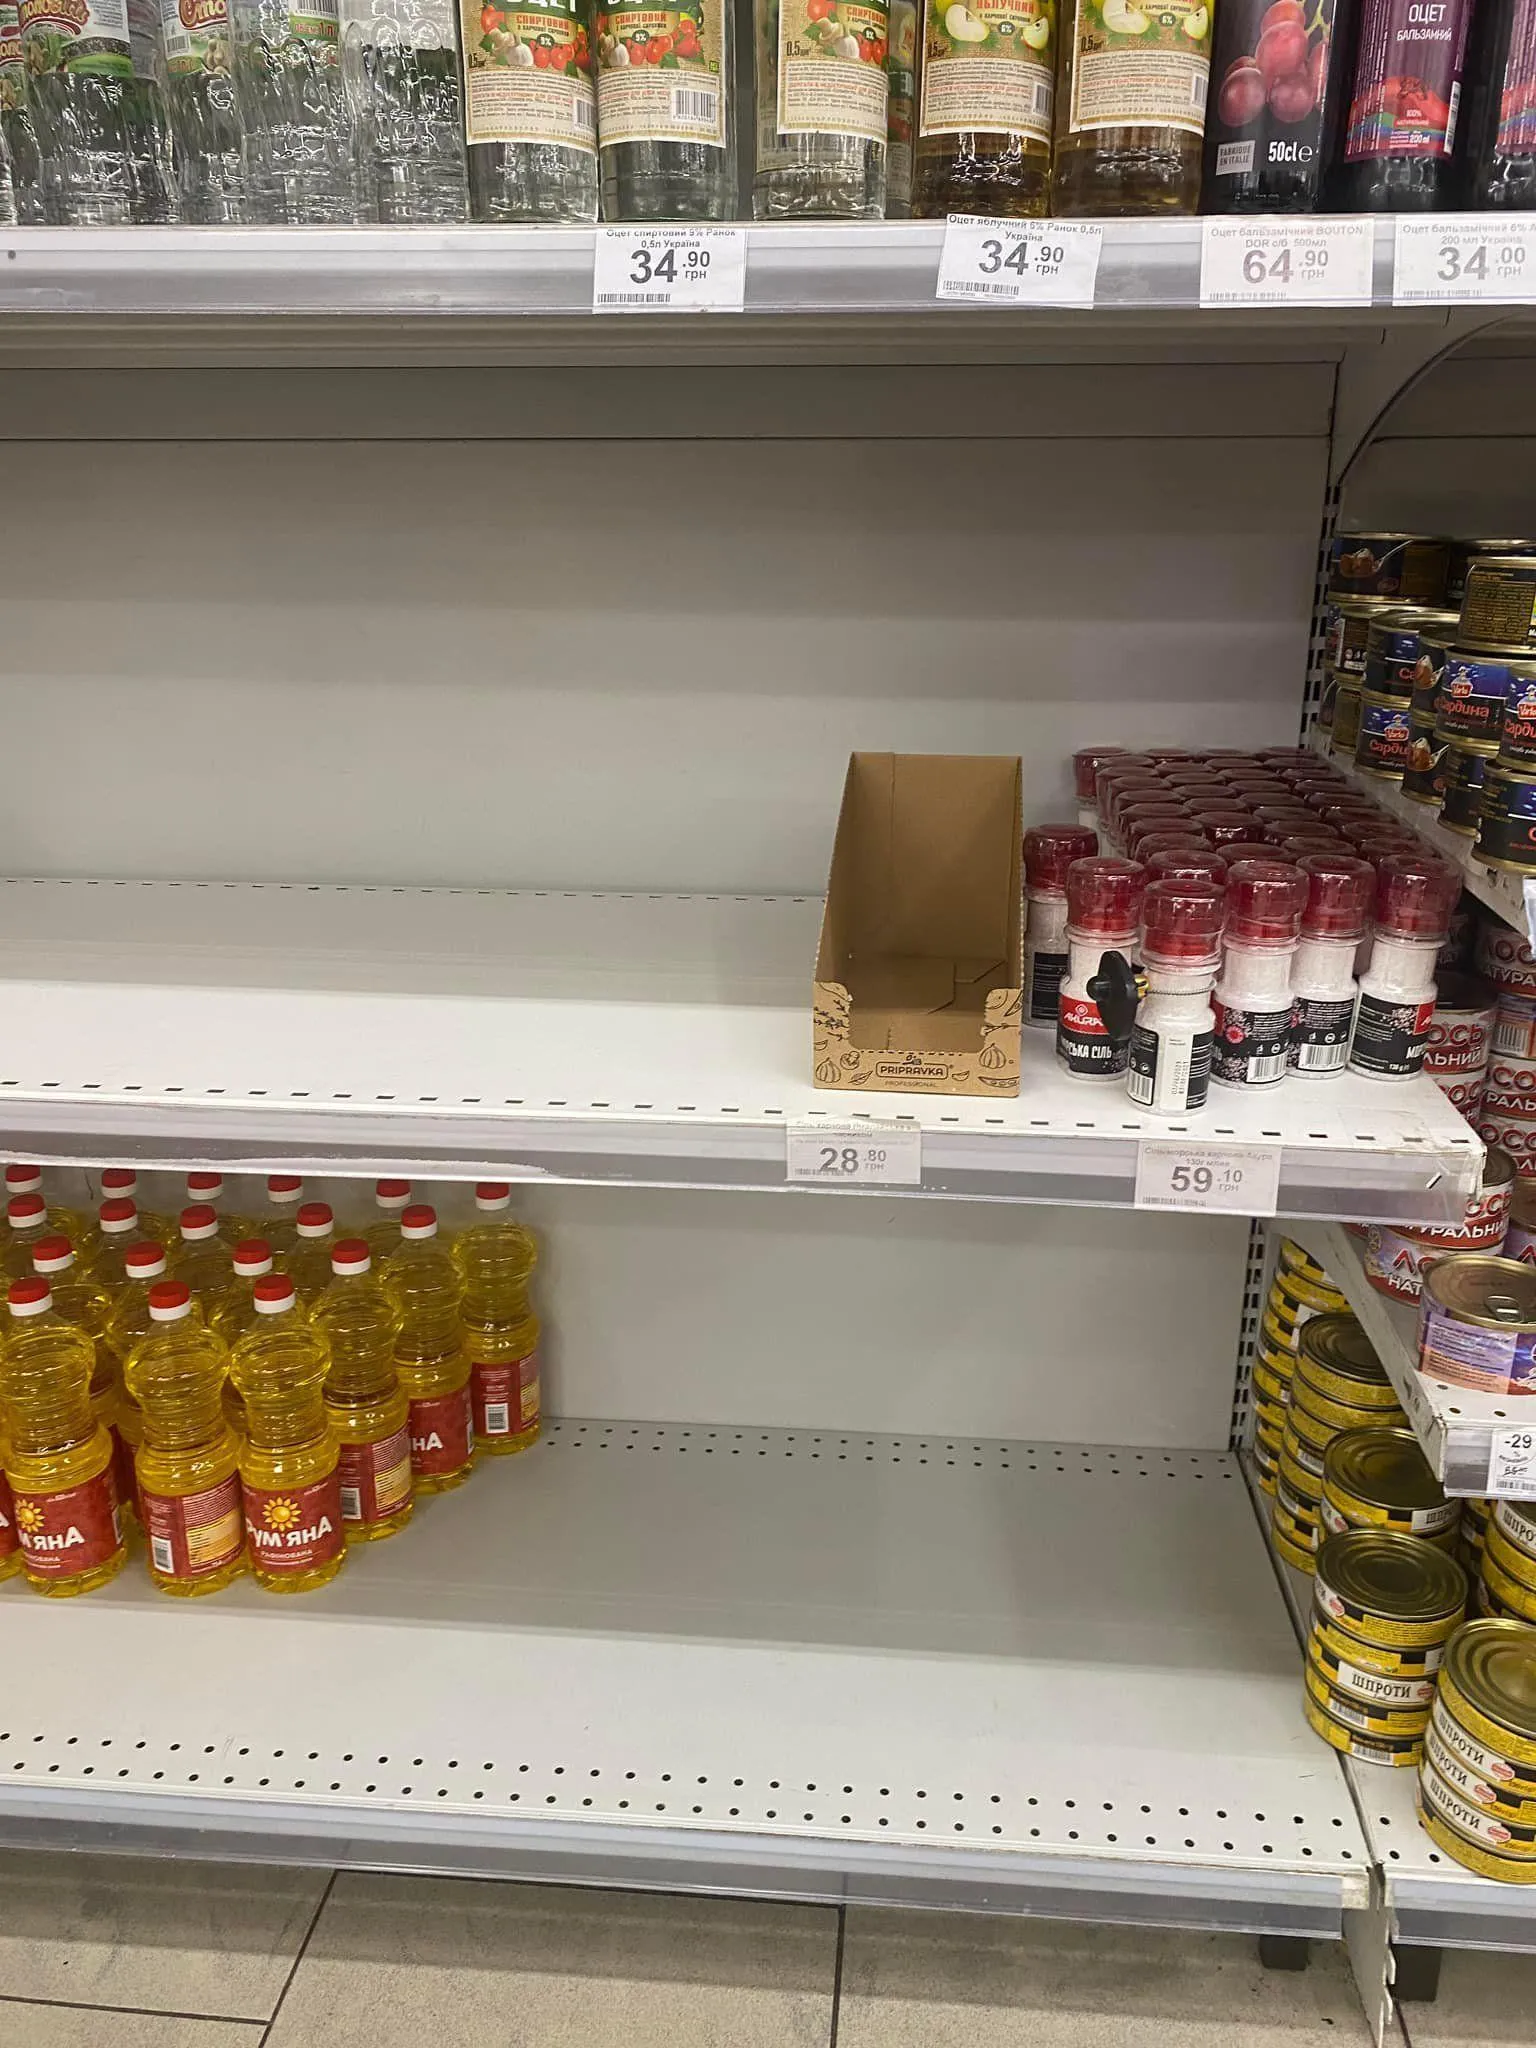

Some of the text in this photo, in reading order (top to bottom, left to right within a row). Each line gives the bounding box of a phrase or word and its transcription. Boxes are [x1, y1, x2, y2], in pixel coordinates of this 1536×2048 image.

[1408, 4, 1447, 25] ОЦЕТ
[1268, 141, 1297, 162] 50cl
[949, 214, 974, 226] Оцет
[977, 217, 1028, 231] яблучний
[1047, 222, 1078, 234] Ранок
[1402, 223, 1429, 234] Оцет
[606, 229, 631, 238] Оцет
[1004, 230, 1044, 242] Україна
[1210, 227, 1237, 238] Оцет
[1315, 226, 1364, 236] BOUTON
[641, 240, 701, 249] 0,5л Україна
[1245, 239, 1269, 248] DOR
[1441, 235, 1460, 245] 200
[1481, 235, 1523, 245] Україна
[978, 239, 1030, 276] 34
[1437, 245, 1490, 281] 34
[630, 248, 678, 284] 34
[1036, 264, 1059, 276] грн
[1242, 248, 1294, 284] 64
[1497, 267, 1521, 278] грн
[685, 270, 707, 282] грн
[1301, 268, 1326, 281] грн
[880, 1065, 944, 1076] PRIPRAVKA
[819, 1147, 860, 1174] 28
[864, 1163, 884, 1172] грн
[1170, 1166, 1214, 1193] 59
[1218, 1184, 1240, 1193] грн
[1504, 1434, 1532, 1449] -29
[1351, 1672, 1412, 1699] ШПРОТИ
[1438, 1711, 1484, 1765] ШПРОТИ
[1429, 1777, 1481, 1829] ШПРОТИ
